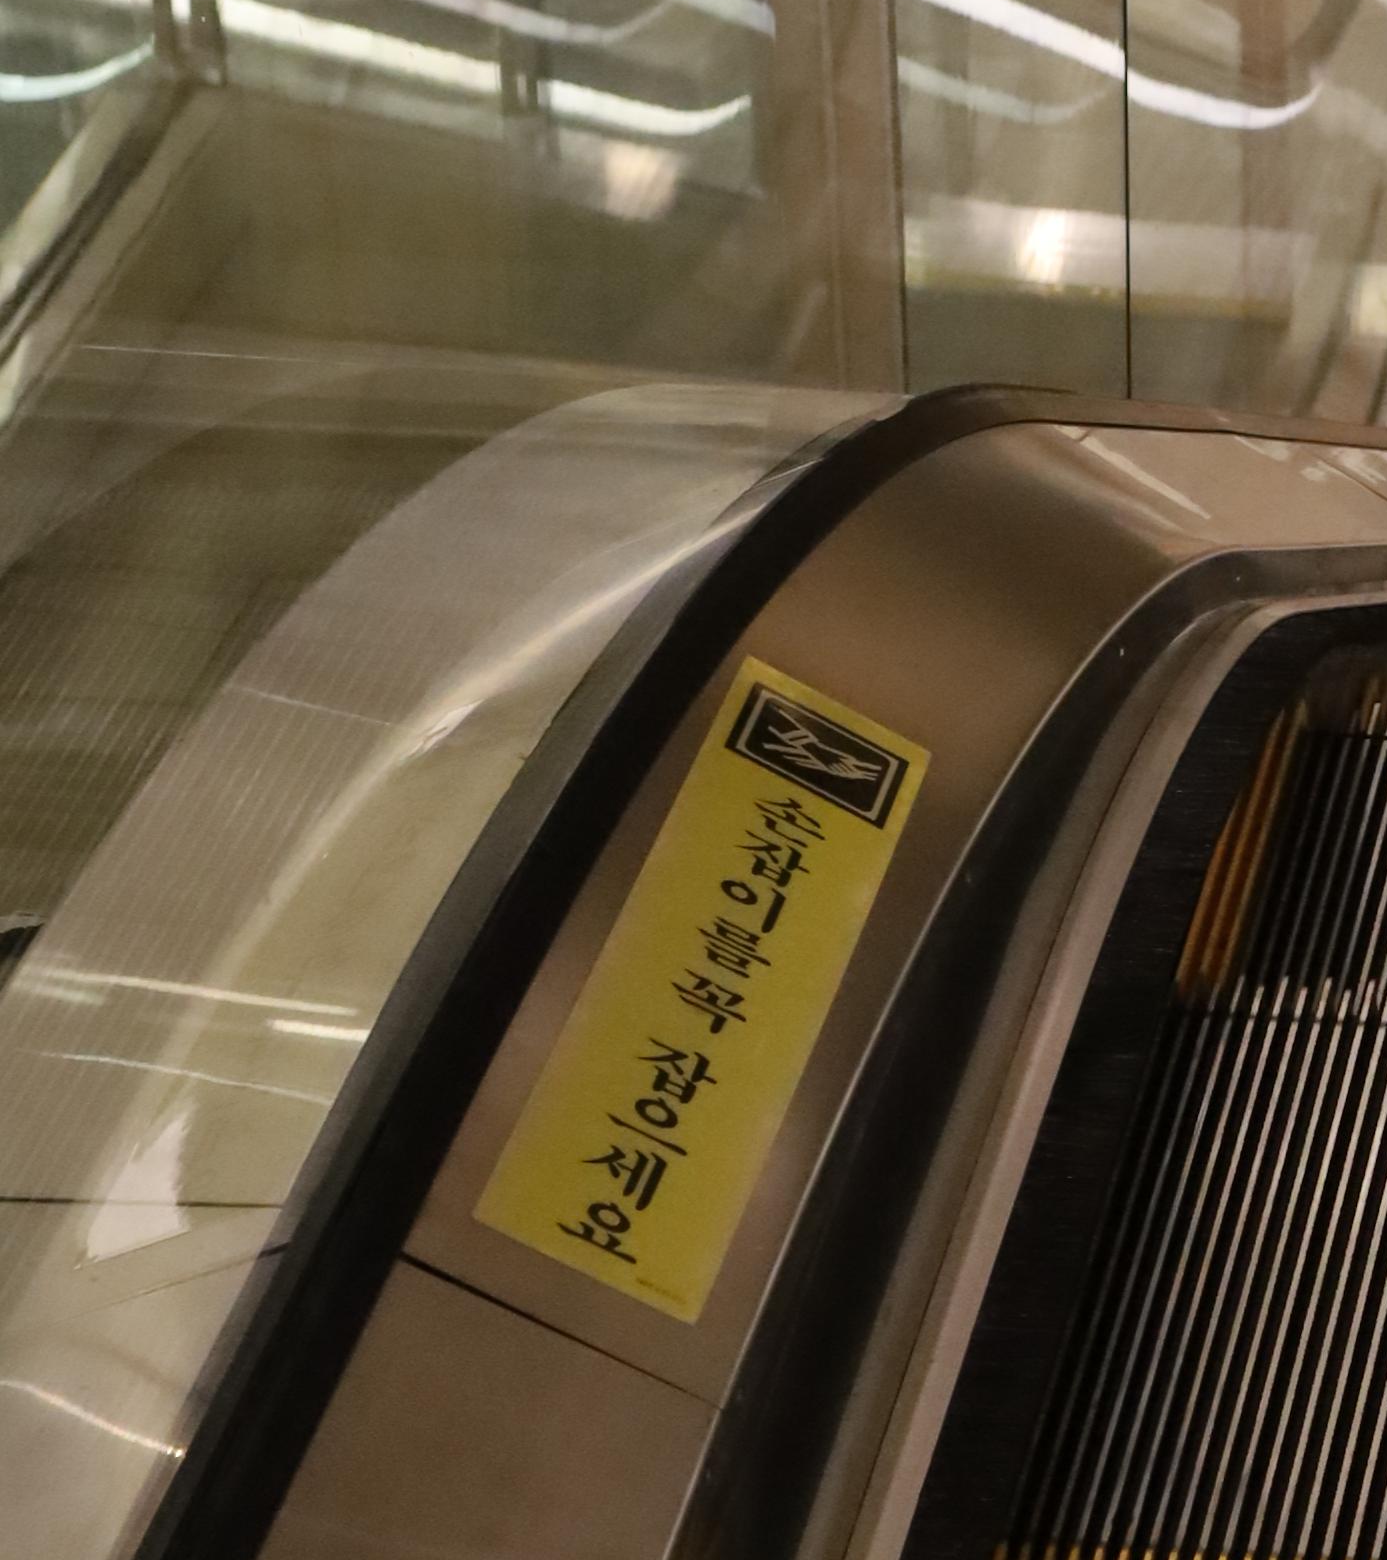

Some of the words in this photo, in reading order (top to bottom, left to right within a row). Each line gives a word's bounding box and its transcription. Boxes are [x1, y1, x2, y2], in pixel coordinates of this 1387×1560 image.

[696, 796, 826, 979] 손잡이를
[671, 968, 748, 1034] 꼭
[556, 1037, 718, 1266] 잡으세요
